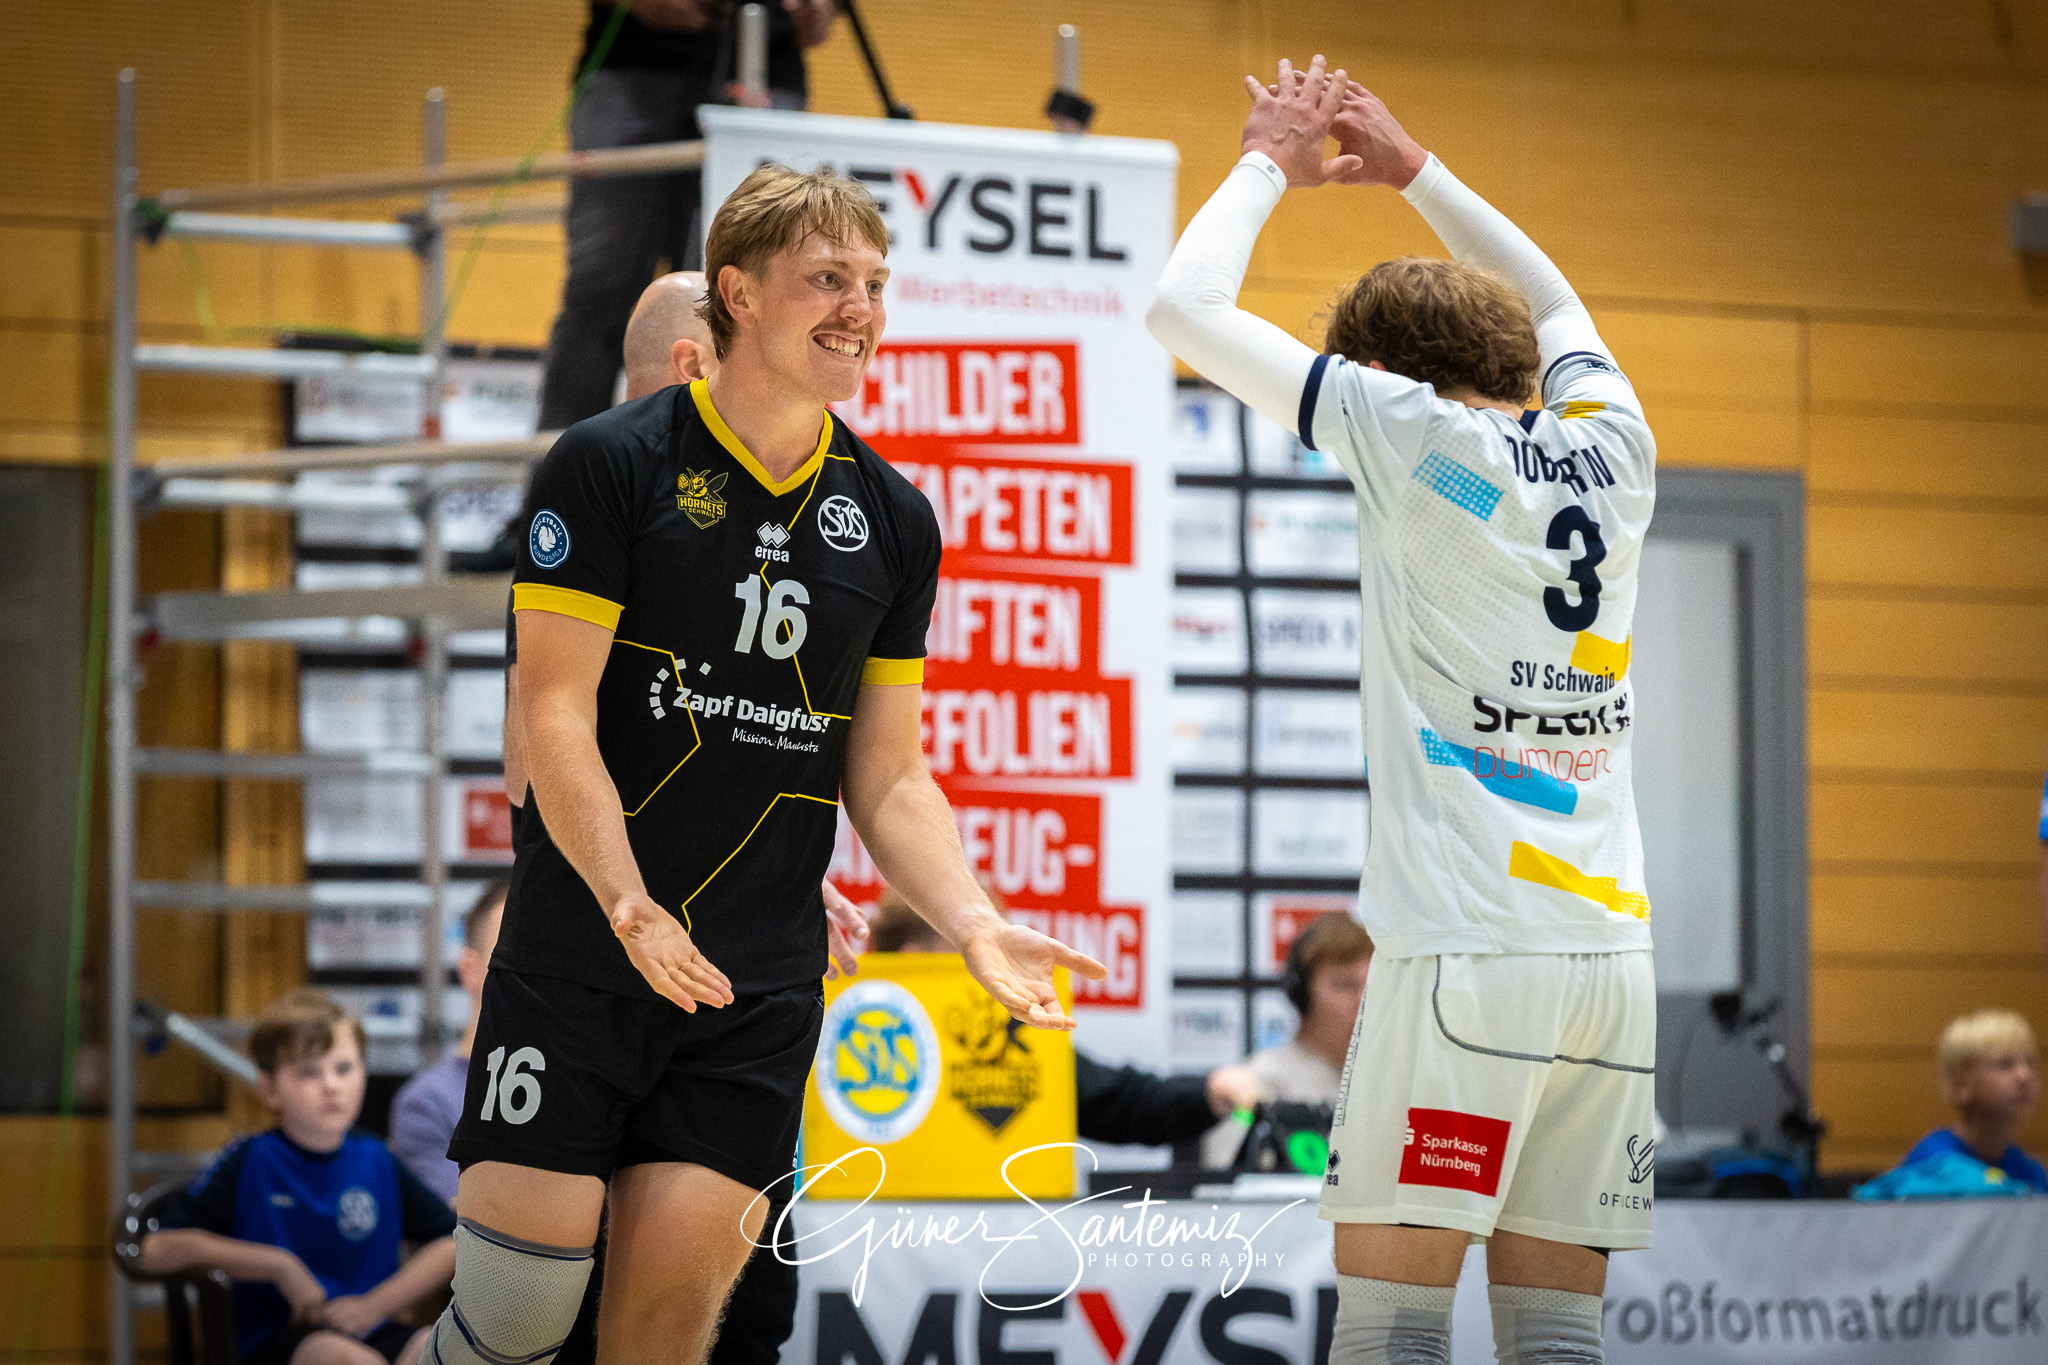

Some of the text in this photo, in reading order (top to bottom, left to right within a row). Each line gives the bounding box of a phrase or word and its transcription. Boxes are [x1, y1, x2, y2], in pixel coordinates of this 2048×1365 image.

[680, 497, 723, 516] HORNETS
[533, 516, 563, 538] VOLLEYBALL
[823, 501, 867, 541] SVS
[533, 544, 563, 562] BUNDESLIGA
[754, 545, 790, 563] errea
[1543, 505, 1607, 632] 3
[734, 573, 811, 660] 16
[1511, 660, 1537, 688] SV
[673, 686, 735, 718] Zapf
[480, 1046, 546, 1125] 16
[1421, 1133, 1488, 1157] Sparkasse
[1420, 1152, 1481, 1177] Nürnberg
[815, 1287, 1338, 1365] MEYS
